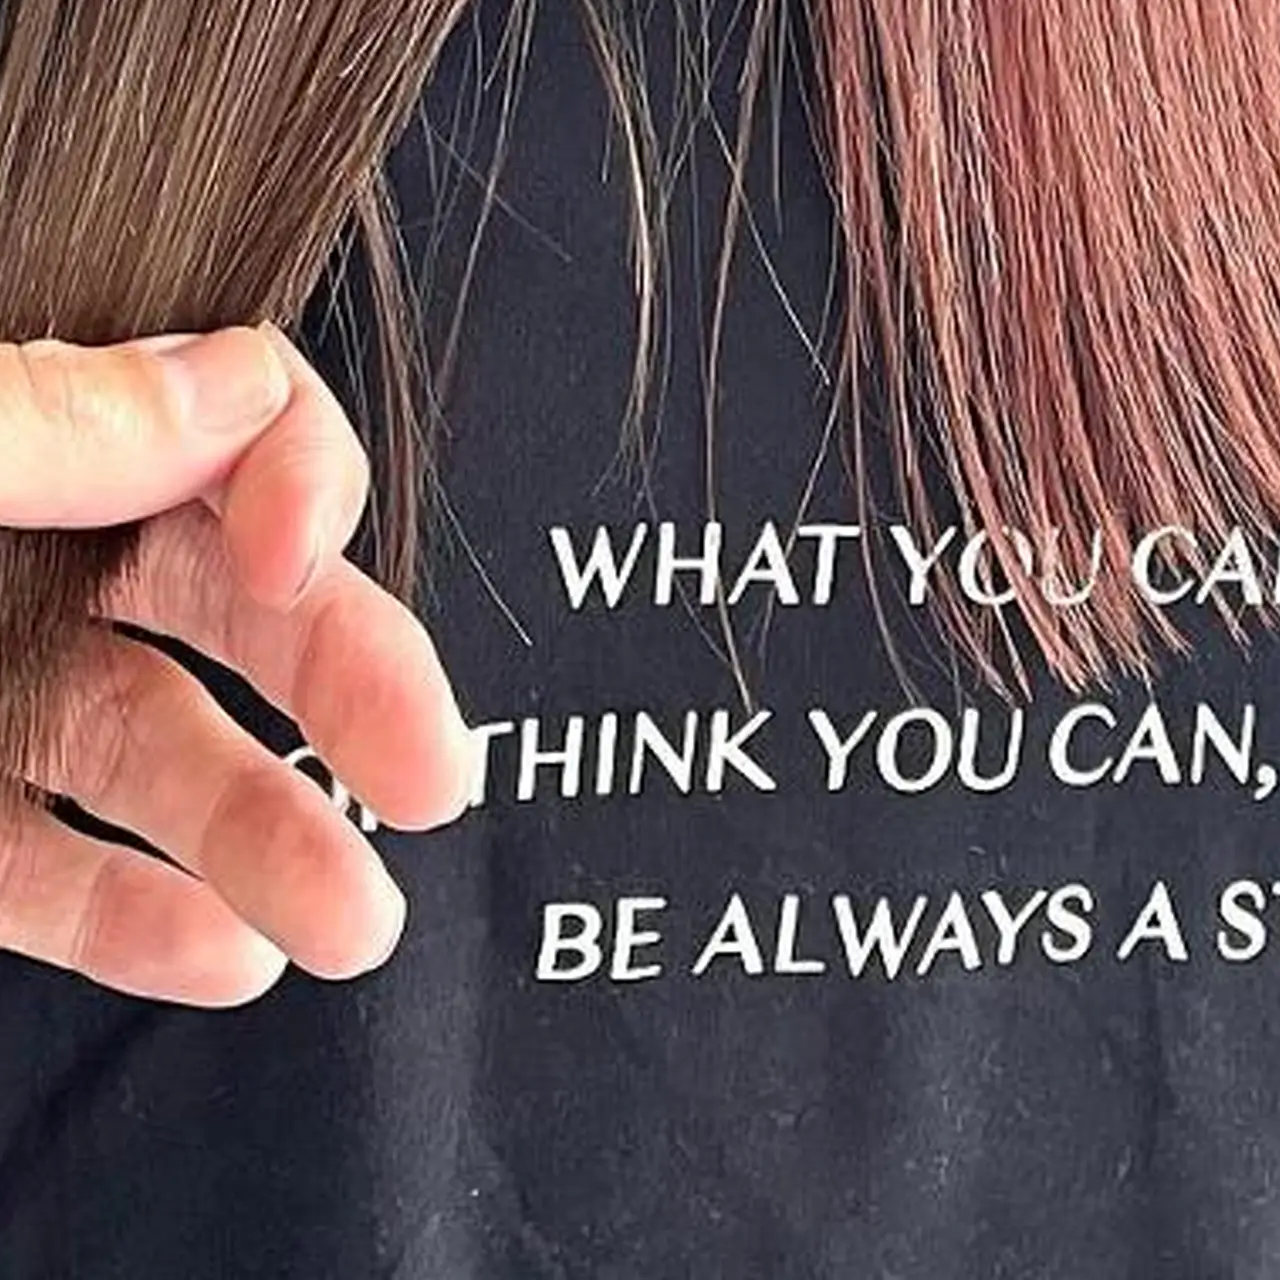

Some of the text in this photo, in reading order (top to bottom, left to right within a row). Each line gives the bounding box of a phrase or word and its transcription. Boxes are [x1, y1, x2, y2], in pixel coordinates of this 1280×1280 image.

[549, 519, 861, 610] WHAT
[888, 524, 1103, 607] YOU
[466, 707, 777, 810] THINK
[808, 705, 1024, 793] YOU
[1049, 702, 1279, 801] CAN,
[535, 895, 669, 983] BE
[691, 883, 1095, 981] ALWAYS
[1118, 880, 1190, 963] A
